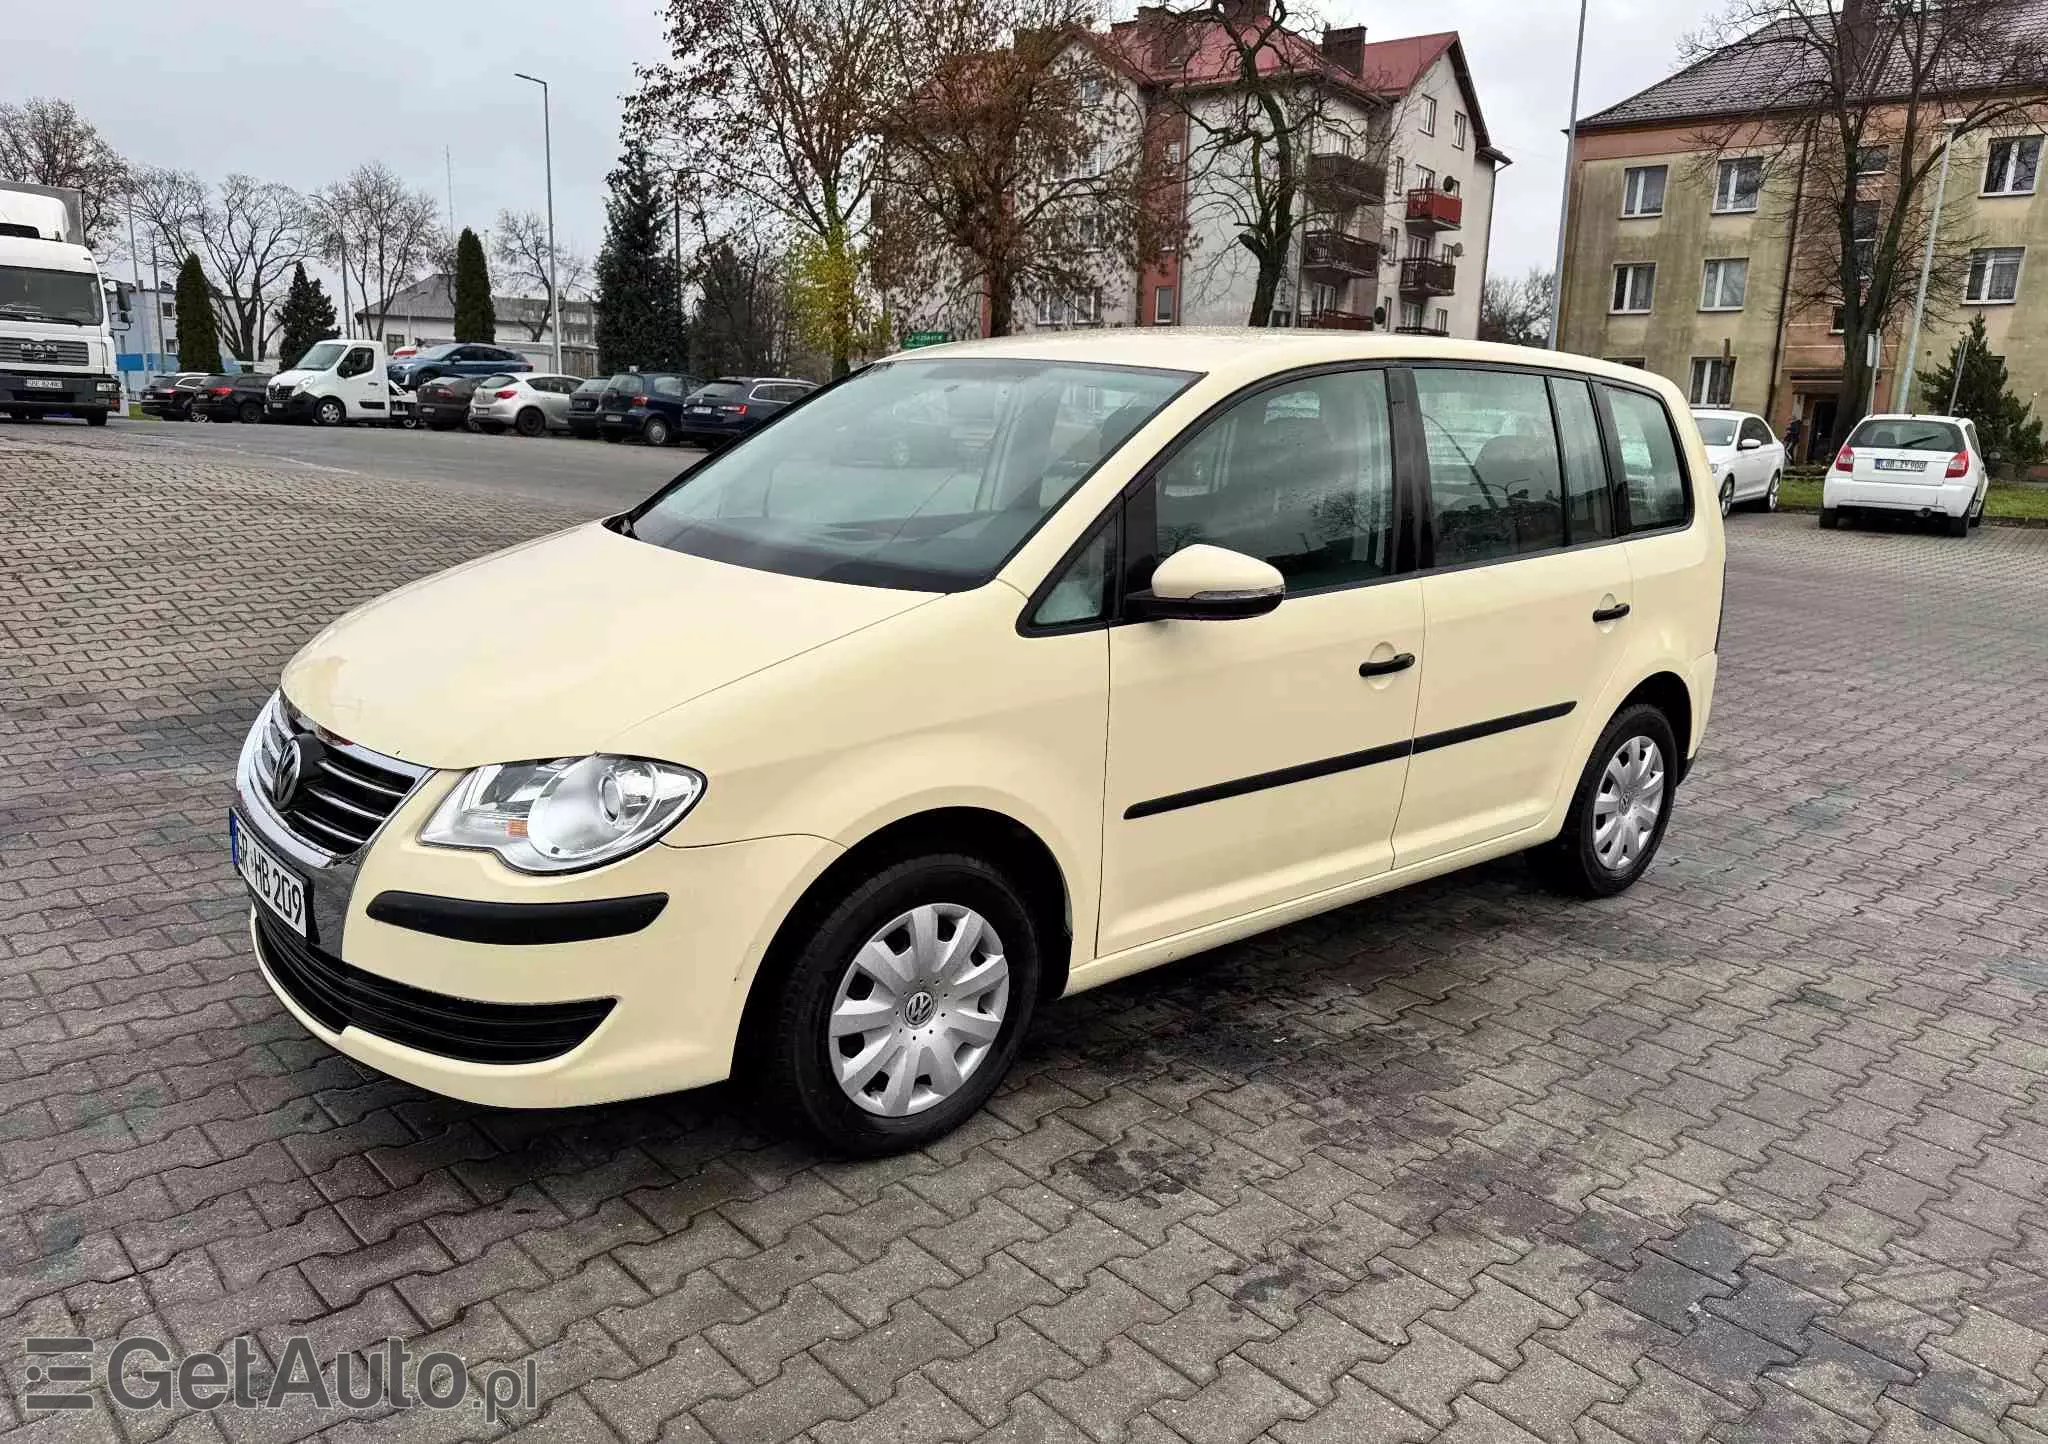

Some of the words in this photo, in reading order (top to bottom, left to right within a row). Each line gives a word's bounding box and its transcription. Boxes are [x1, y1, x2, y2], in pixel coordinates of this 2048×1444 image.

[20, 343, 57, 352] MAN
[254, 847, 271, 898] HB
[273, 867, 302, 925] 209
